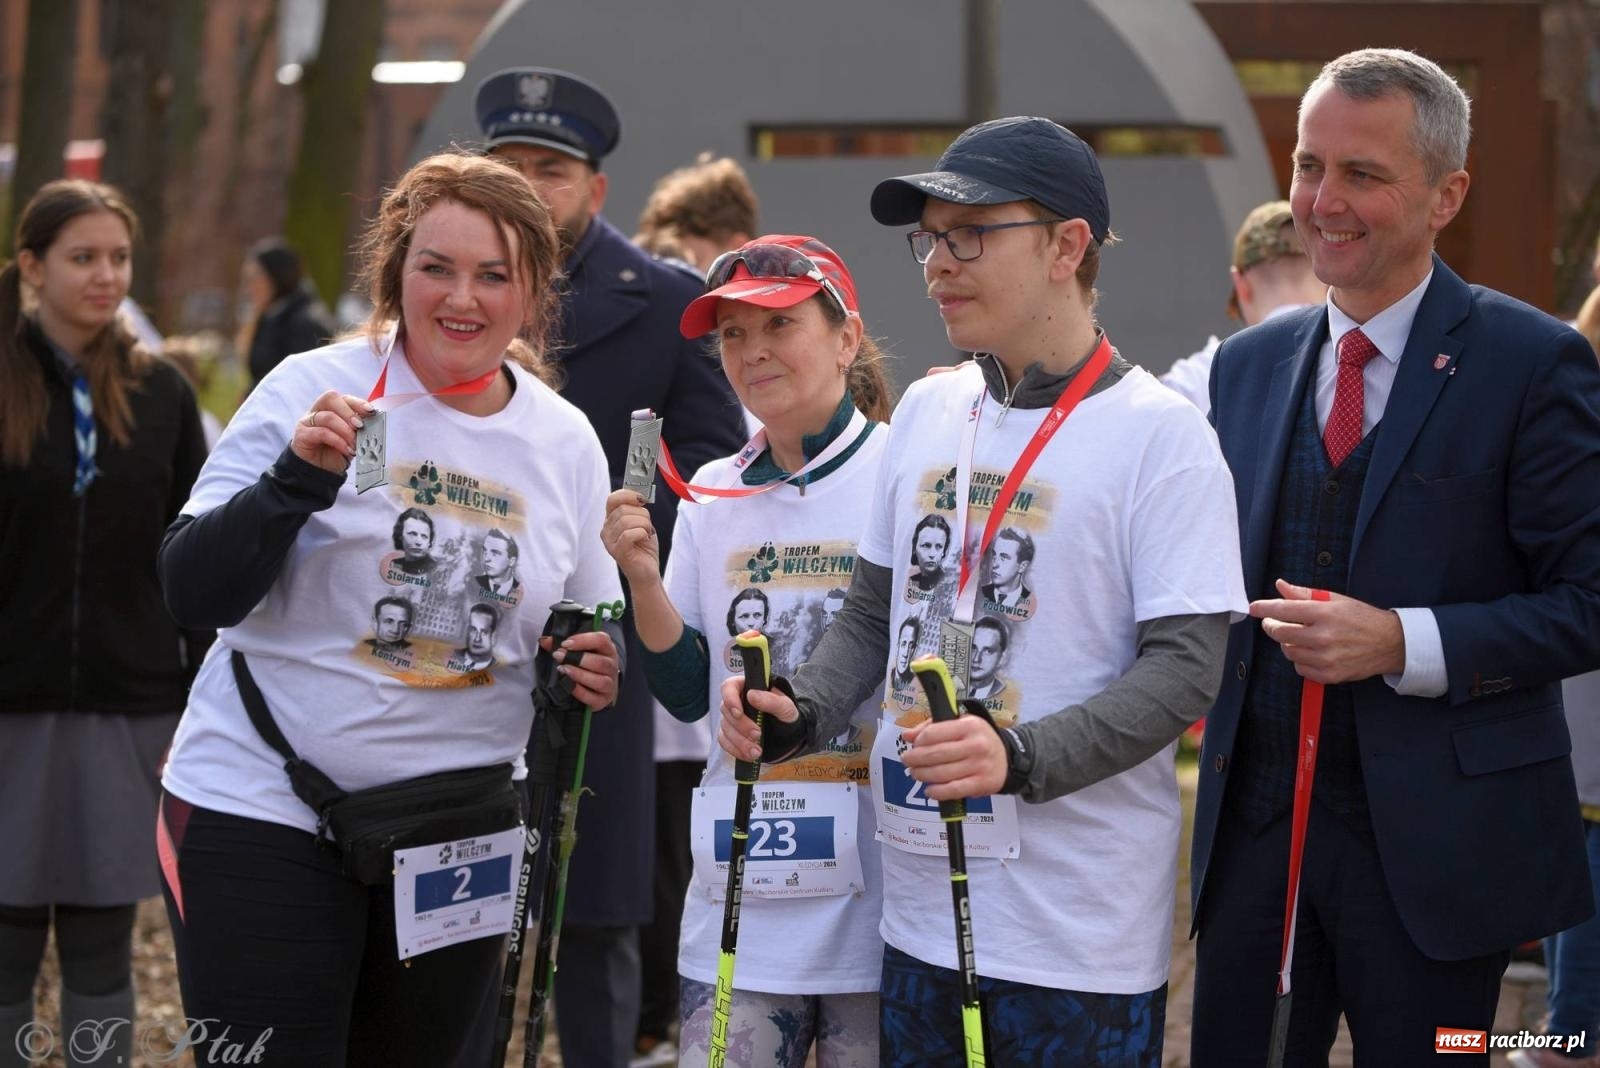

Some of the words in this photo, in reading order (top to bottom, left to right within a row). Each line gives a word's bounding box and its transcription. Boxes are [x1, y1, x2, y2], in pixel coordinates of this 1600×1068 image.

[446, 472, 480, 490] TROPEM
[972, 472, 1006, 486] TROPEM
[447, 485, 508, 517] WILCZYM
[784, 546, 821, 556] TROPEM
[783, 556, 854, 574] WILCZYM
[761, 791, 785, 799] TROPEM
[761, 799, 806, 812] WILCZYM
[750, 819, 797, 857] 23
[456, 843, 492, 860] WILCZYM
[451, 866, 473, 902] 2
[730, 853, 746, 932] GABEL
[508, 863, 531, 953] SPRINGOS
[959, 897, 978, 985] GABEL
